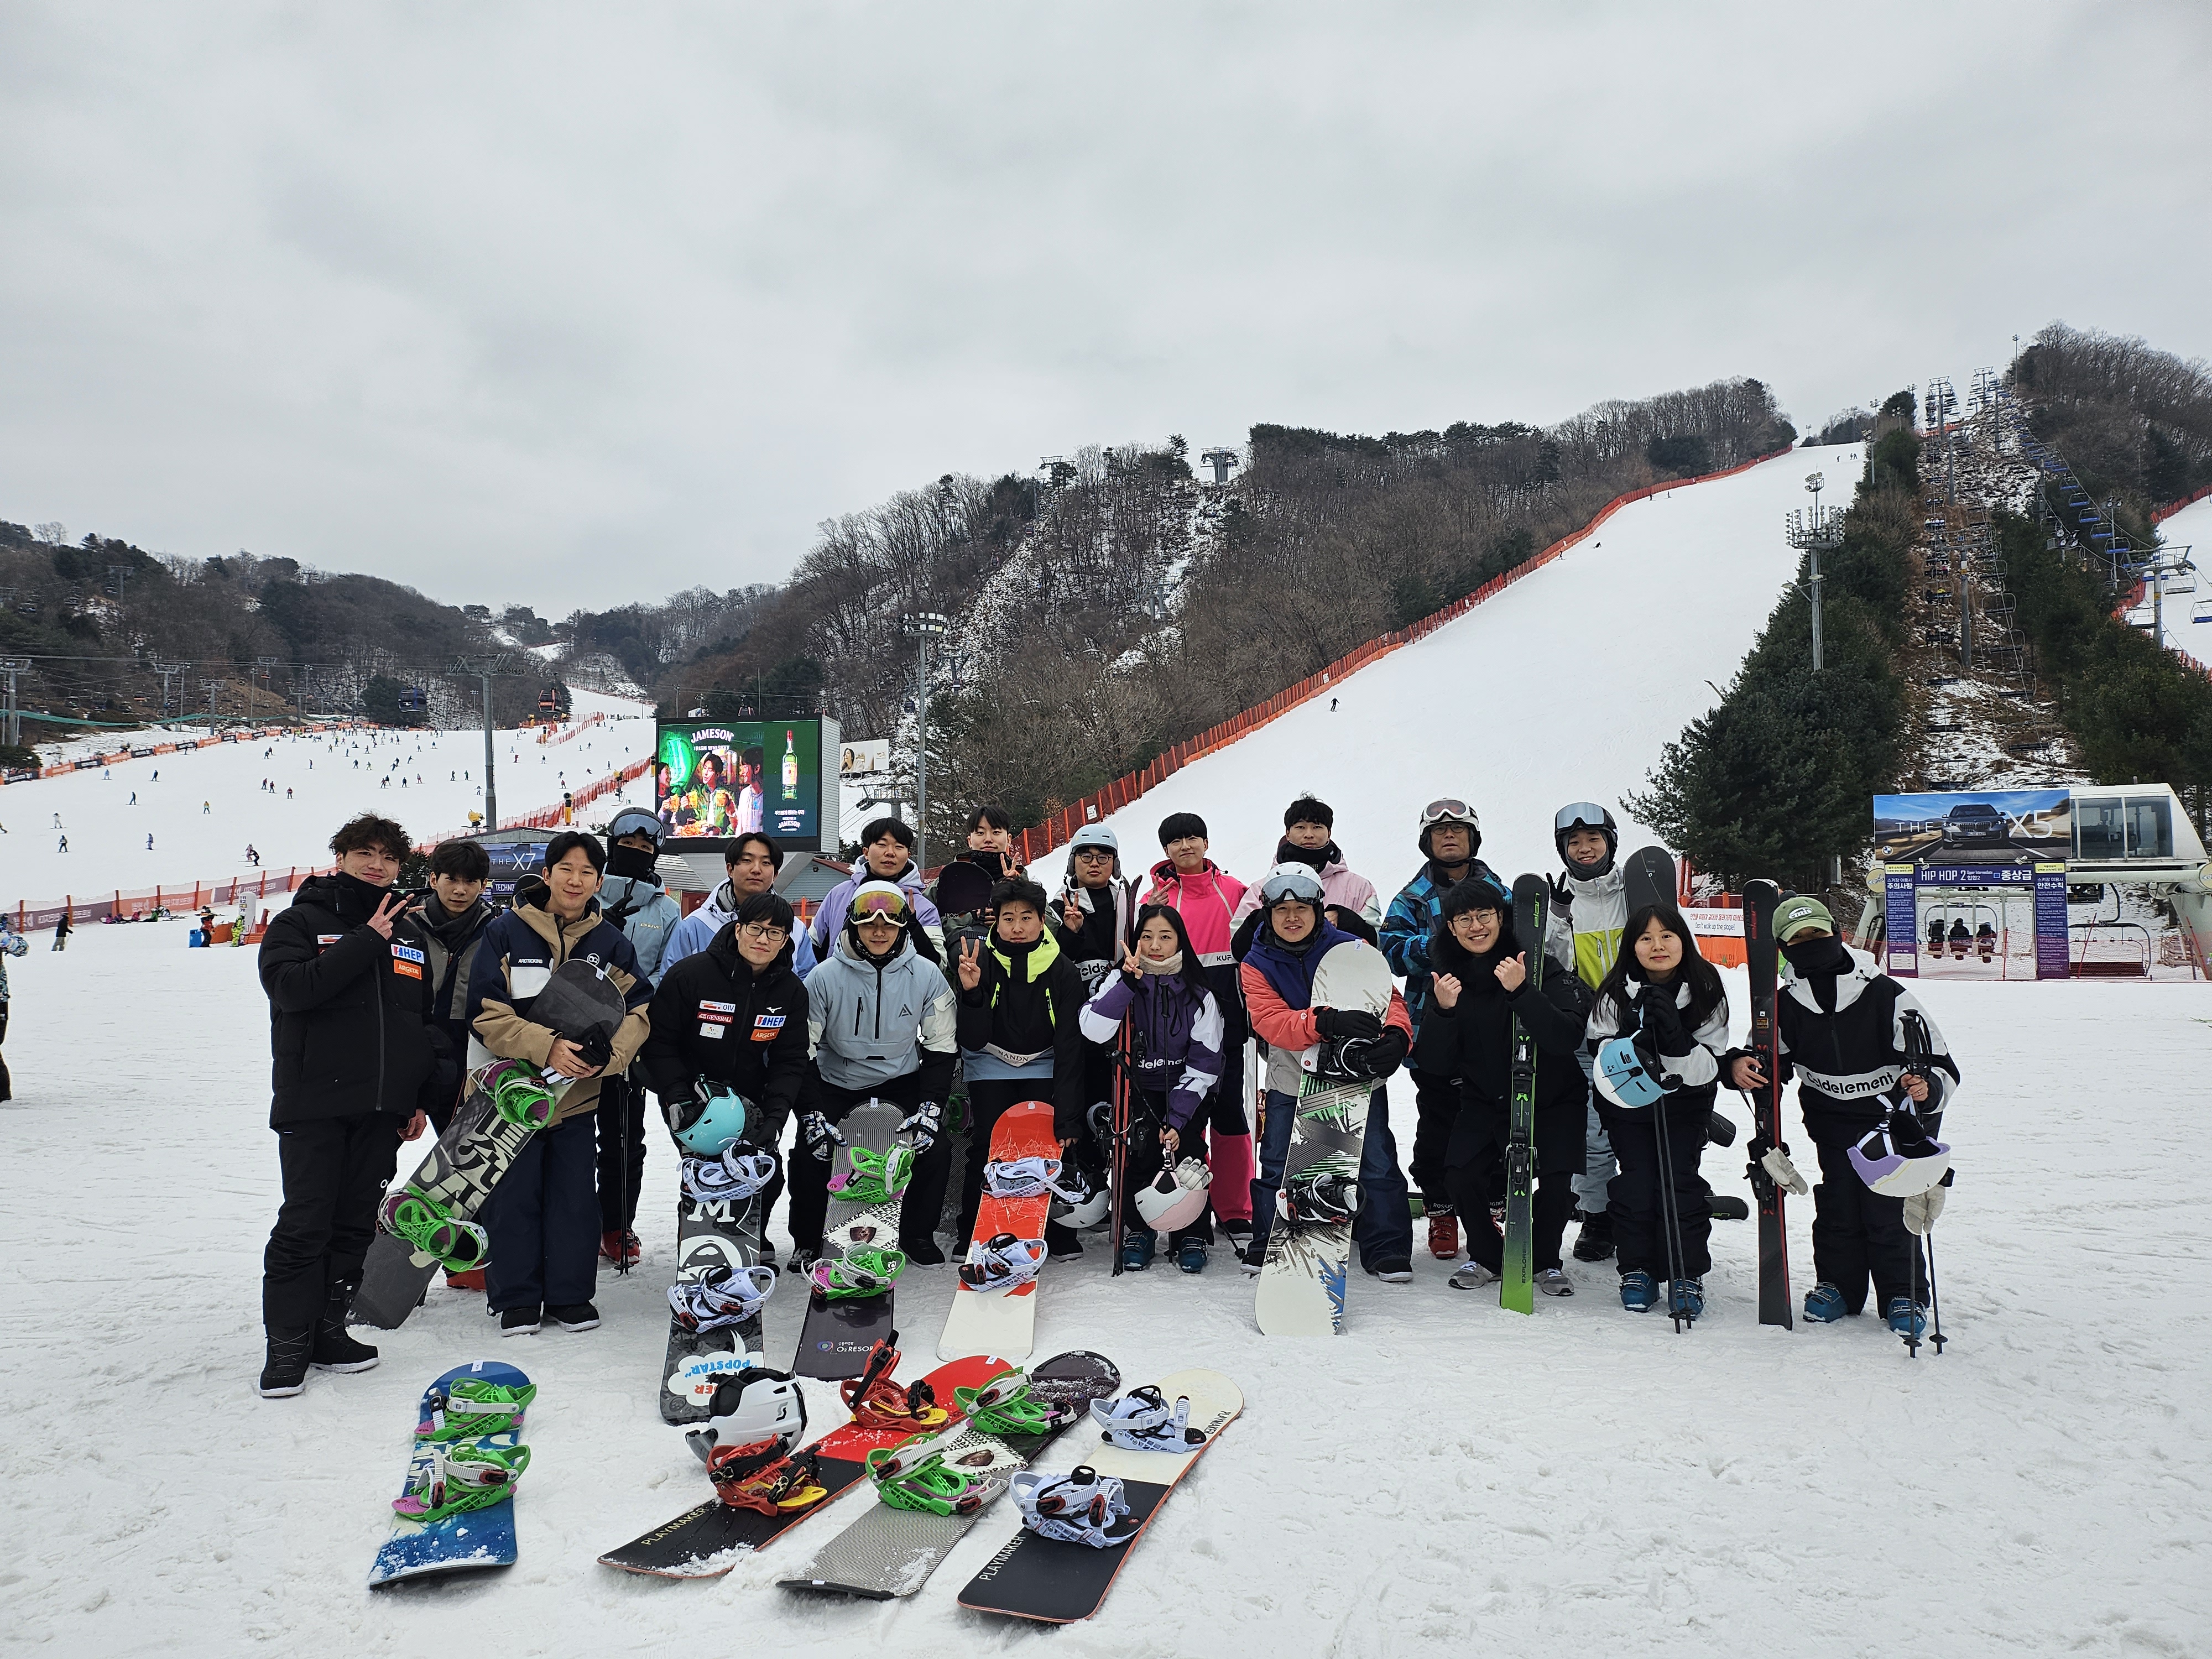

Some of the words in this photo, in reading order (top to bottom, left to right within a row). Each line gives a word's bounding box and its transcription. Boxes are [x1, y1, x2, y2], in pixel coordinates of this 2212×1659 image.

[691, 728, 733, 743] JAMESON
[1895, 821, 1934, 833] THE
[2006, 809, 2053, 838] X5
[512, 853, 536, 870] X7
[1921, 870, 1936, 881] HIP
[1939, 870, 1958, 881] HOP
[1960, 870, 1966, 881] 2
[2001, 870, 2032, 881] 중상급
[398, 964, 420, 975] ARGETA
[706, 1014, 732, 1023] GENERALI
[1204, 1411, 1232, 1435] PLAYMAKER
[640, 1507, 709, 1545] PLAYMAKER
[978, 1535, 1026, 1581] PLAYMAKER
